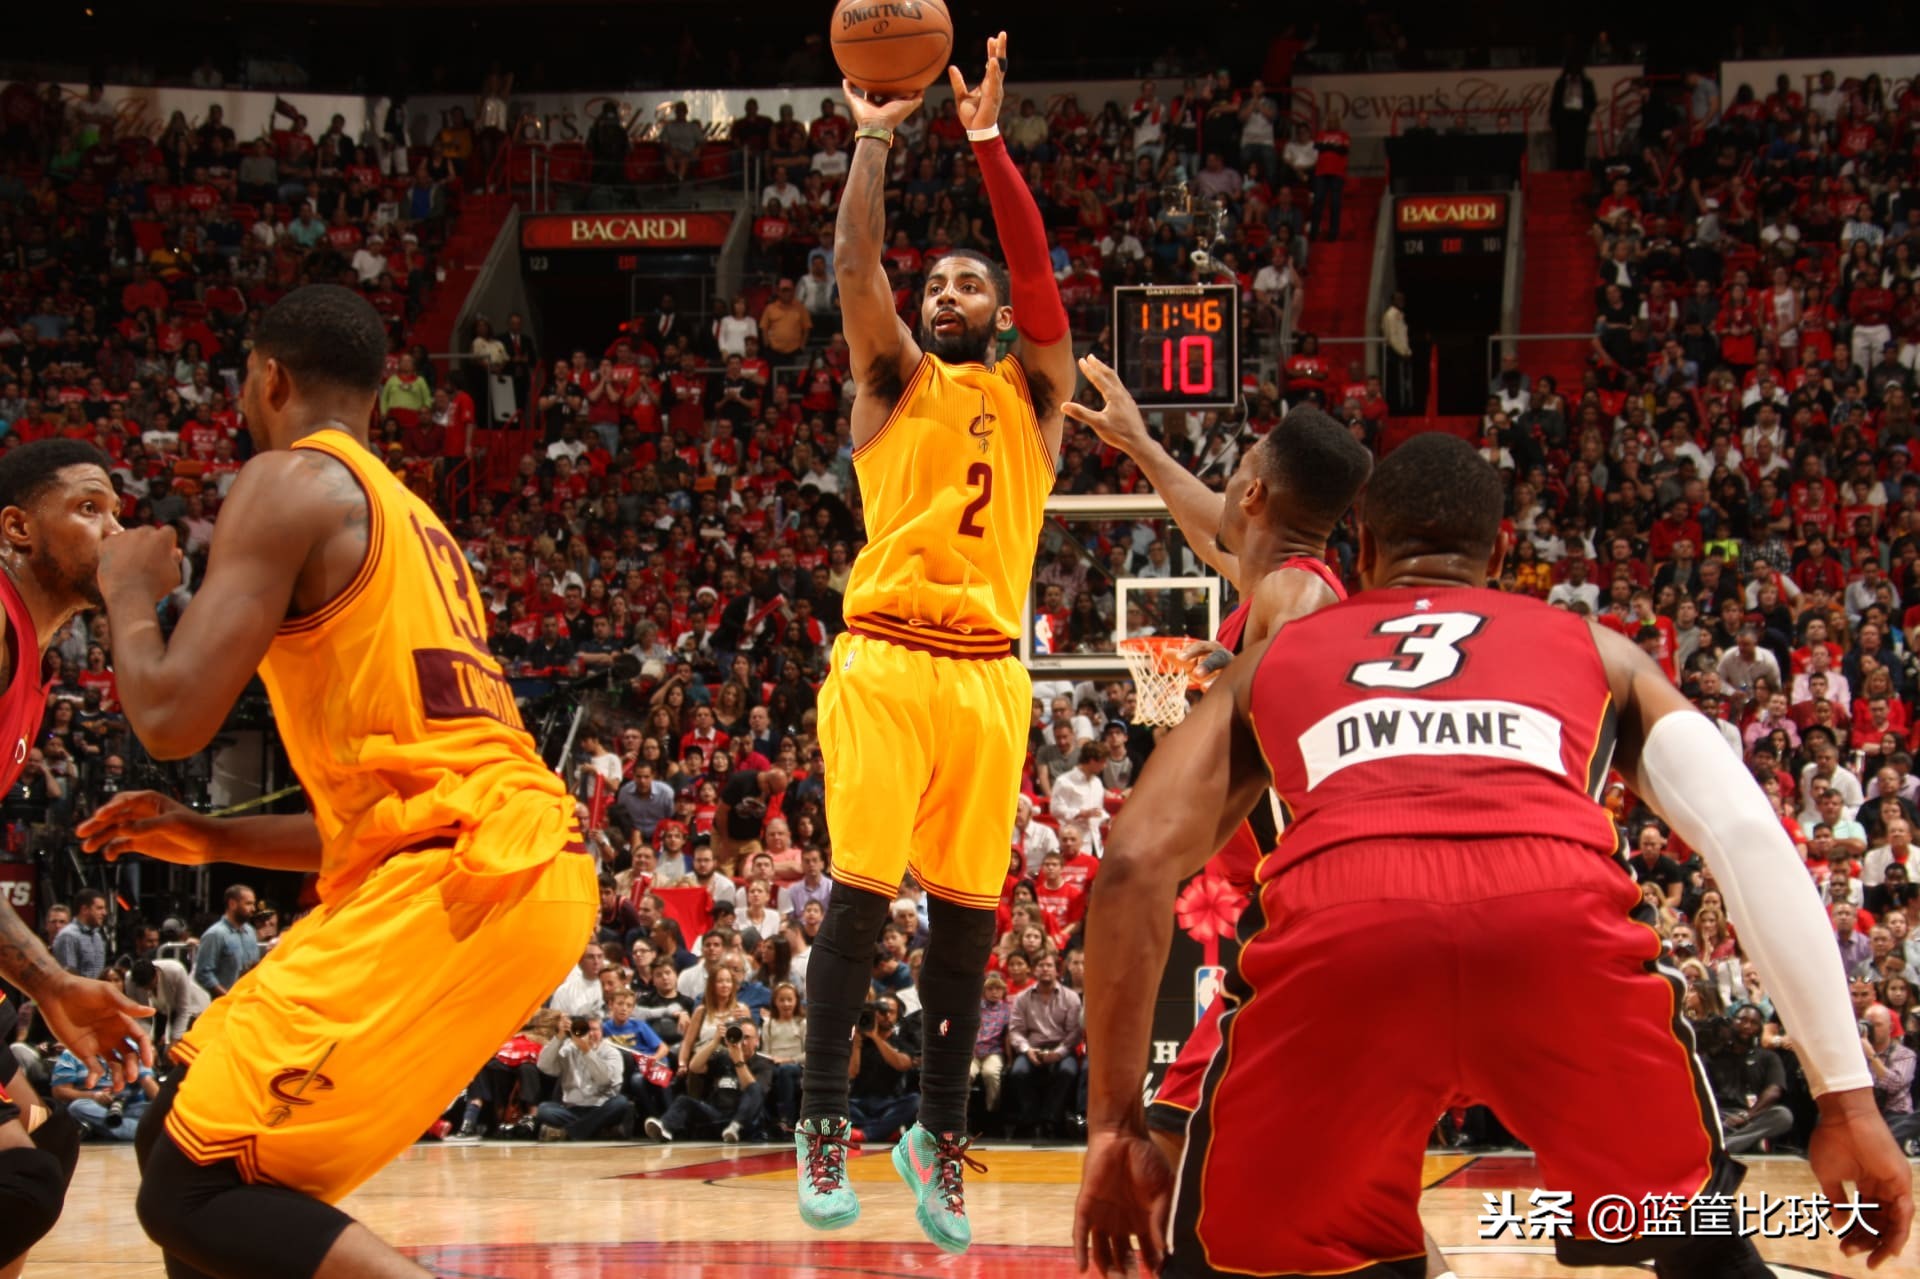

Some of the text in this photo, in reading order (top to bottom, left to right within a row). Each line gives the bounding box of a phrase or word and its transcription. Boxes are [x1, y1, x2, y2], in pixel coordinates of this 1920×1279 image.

[842, 2, 922, 30] SPALDING
[571, 217, 687, 241] BACARDI
[1402, 202, 1496, 224] BACARDI
[529, 255, 549, 271] 123
[1142, 299, 1222, 332] 11:46
[1162, 335, 1213, 394] 10
[958, 462, 992, 538] 2
[410, 511, 492, 657] 13
[1346, 611, 1489, 692] 3
[1337, 710, 1522, 758] DWYANE
